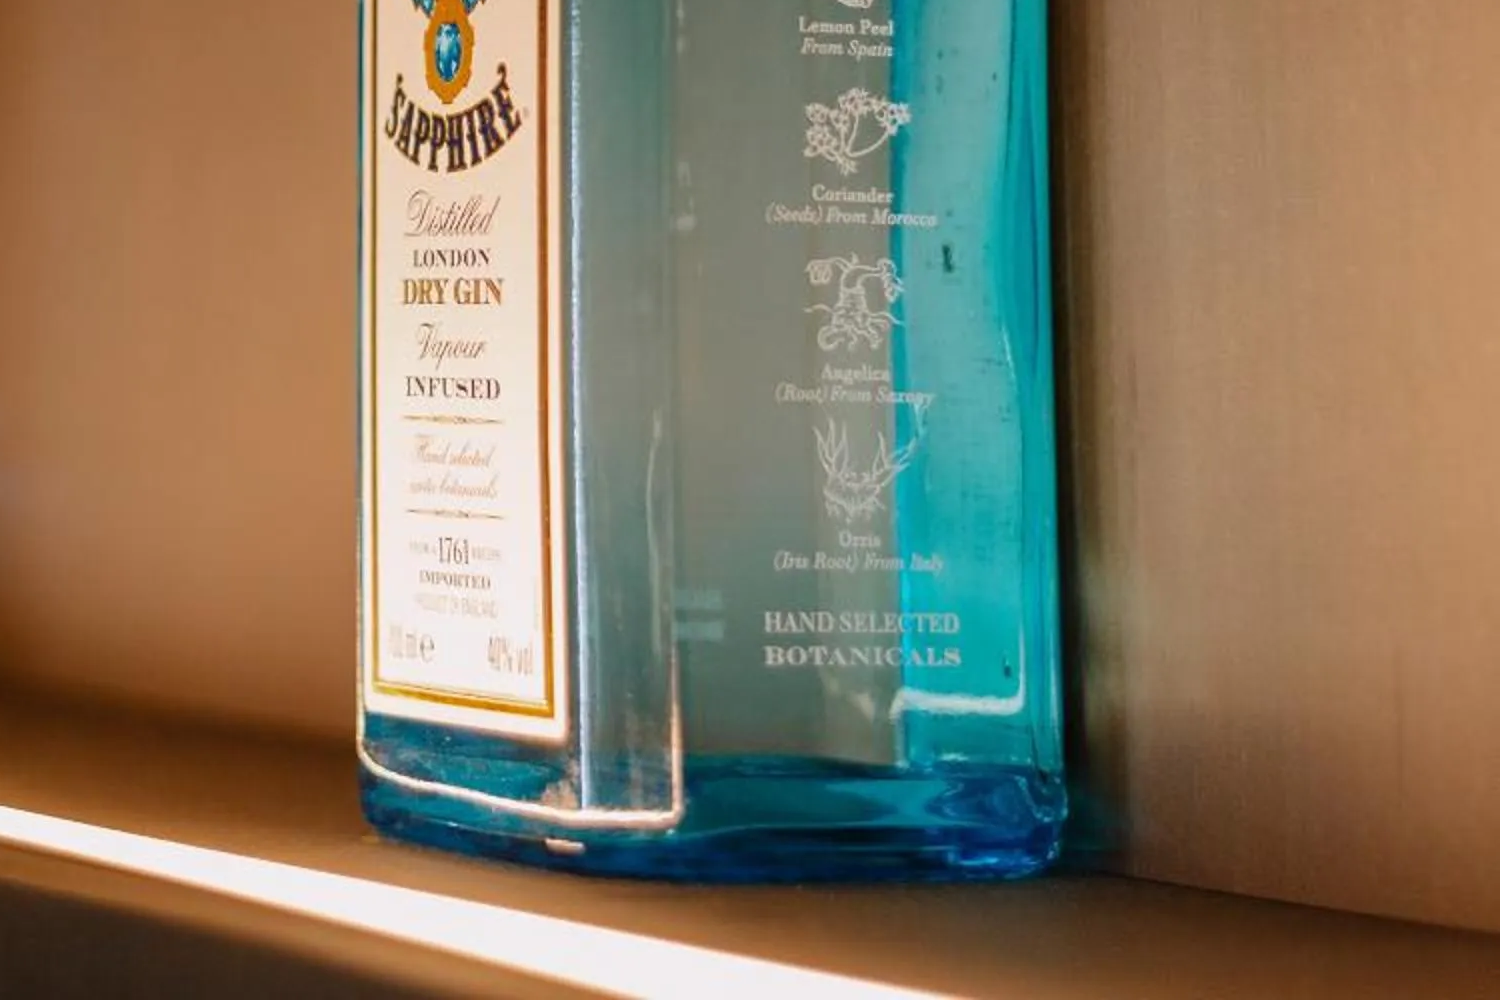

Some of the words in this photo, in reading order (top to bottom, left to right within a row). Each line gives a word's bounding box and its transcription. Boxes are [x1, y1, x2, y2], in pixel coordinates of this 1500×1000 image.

[798, 15, 854, 35] Lemon
[859, 18, 894, 36] Peel
[800, 37, 845, 56] From
[847, 39, 894, 61] Spain
[384, 62, 523, 173] SAPPHIRE
[811, 183, 894, 204] Coriander
[403, 189, 501, 238] Distilled
[765, 202, 824, 226] (Seeds)
[825, 206, 868, 225] From
[871, 207, 938, 227] Morocco
[412, 248, 491, 269] LONDON
[402, 278, 448, 305] DRY
[453, 277, 504, 306] GIN
[415, 322, 488, 371] Vapour
[821, 364, 891, 385] Angelica
[405, 375, 501, 400] INFUSED
[774, 382, 828, 404] (Root)
[829, 384, 872, 403] From
[438, 536, 470, 565] 1761
[838, 530, 882, 548] Orris
[773, 550, 809, 571] (Iris
[813, 551, 860, 572] Root)
[863, 552, 905, 571] From
[419, 569, 492, 590] IMPORTED
[763, 610, 835, 634] HAND
[839, 611, 961, 634] SELECTED
[763, 644, 962, 668] BOTANICALS
